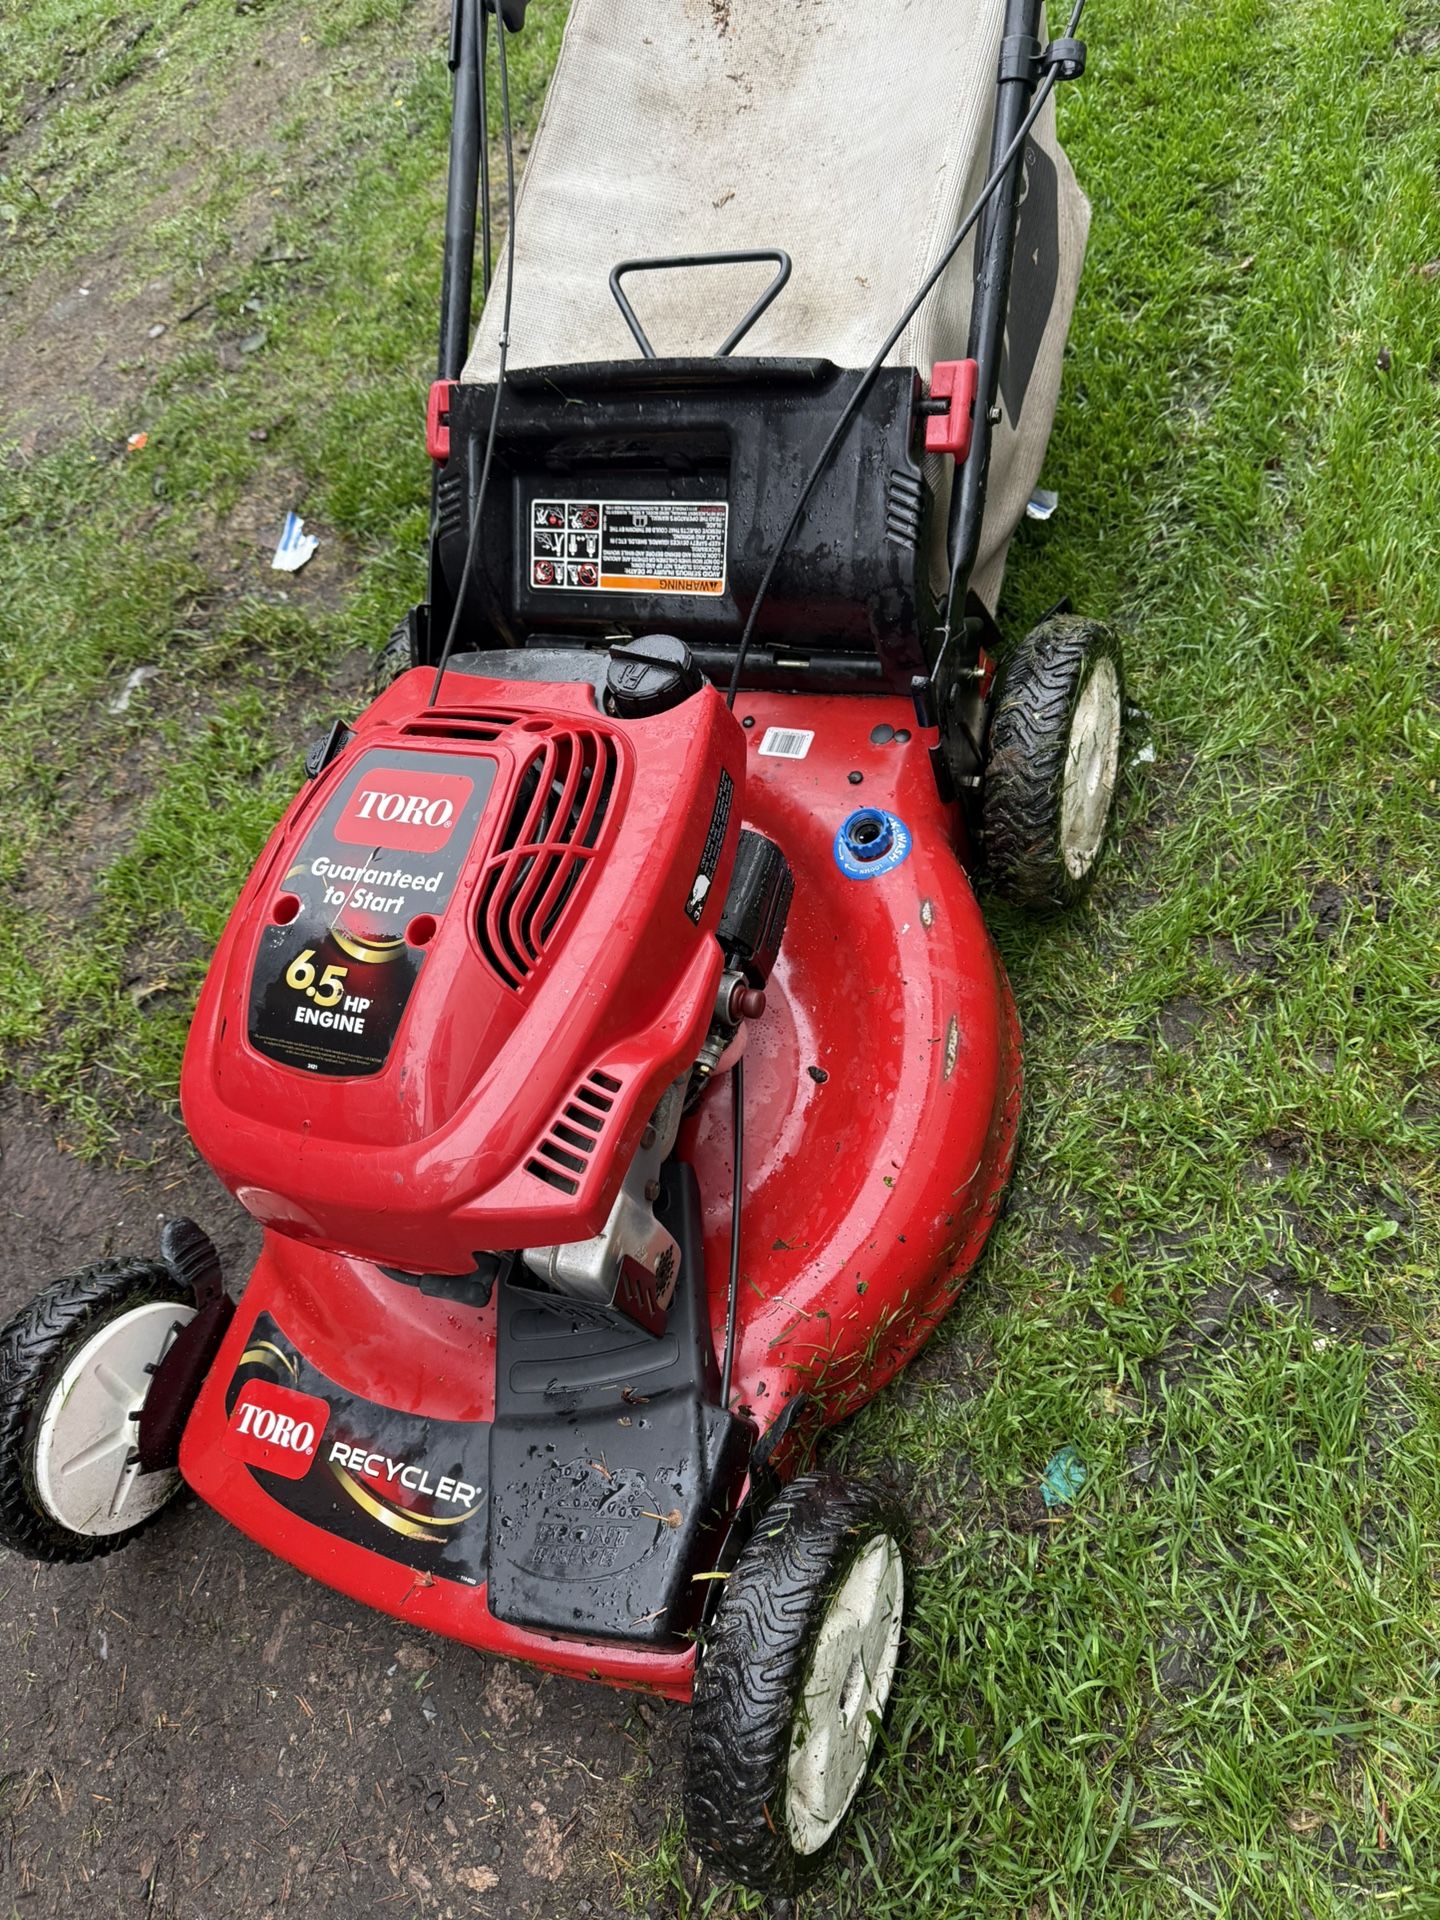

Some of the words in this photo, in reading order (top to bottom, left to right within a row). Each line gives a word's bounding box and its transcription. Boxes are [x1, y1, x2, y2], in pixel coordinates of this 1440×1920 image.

[659, 580, 710, 592] WARNING
[355, 791, 453, 827] TORO
[311, 857, 445, 894] Guaranteed
[322, 885, 346, 906] to
[350, 887, 406, 914] Start
[285, 949, 349, 1007] 6.5
[294, 1006, 366, 1035] ENGINE
[237, 1402, 315, 1453] TORO
[328, 1441, 477, 1508] RECYCLER
[534, 1521, 634, 1547] FRONT
